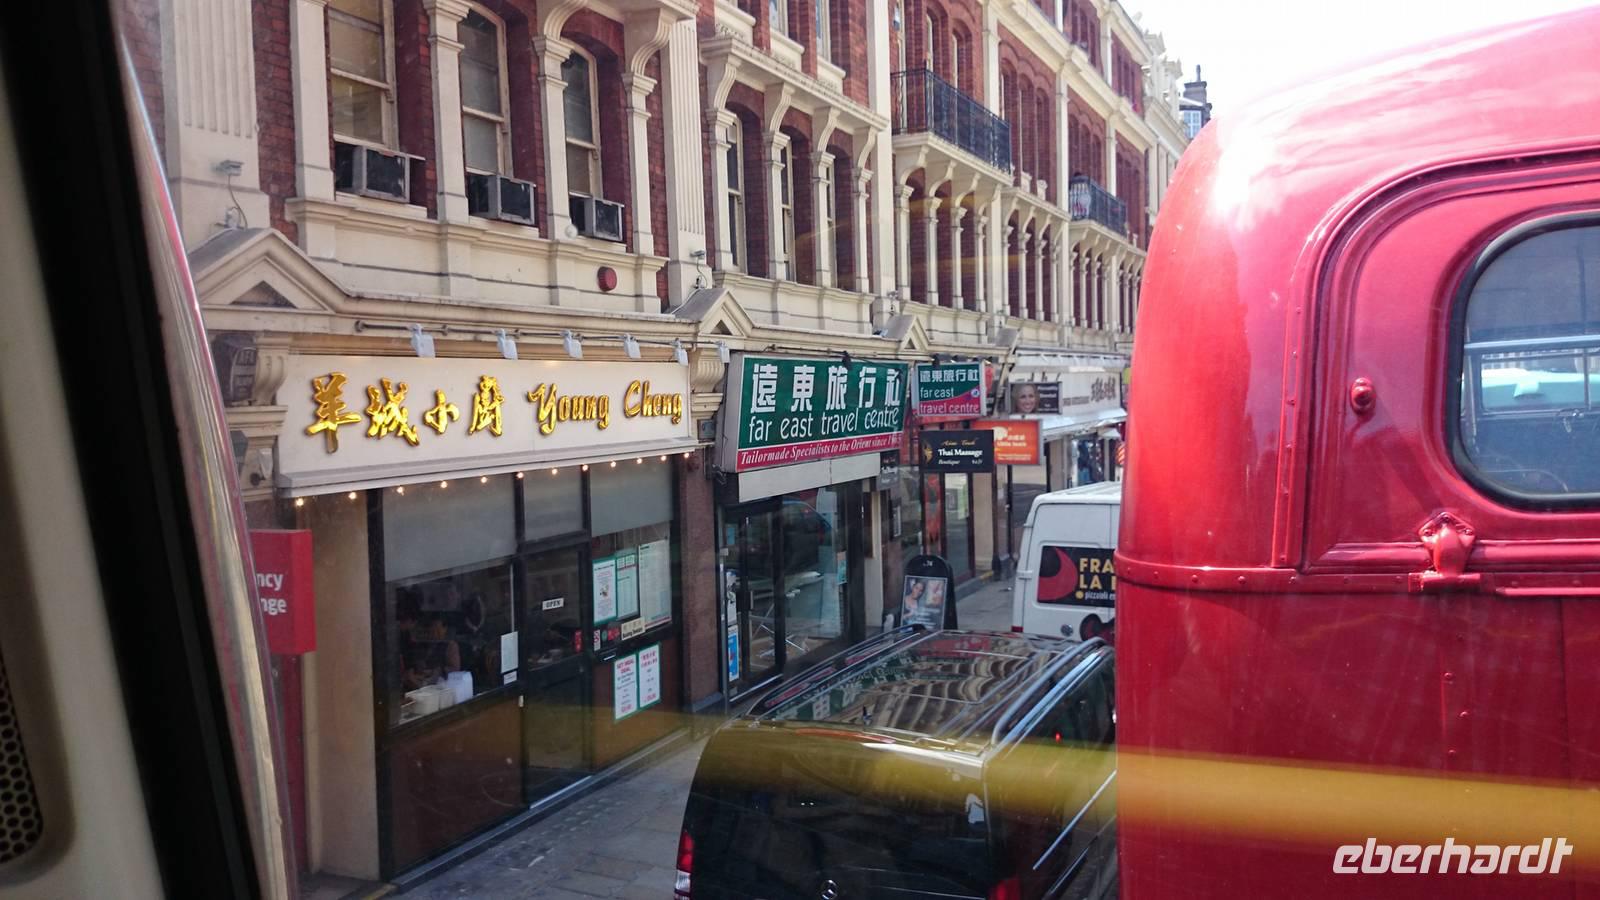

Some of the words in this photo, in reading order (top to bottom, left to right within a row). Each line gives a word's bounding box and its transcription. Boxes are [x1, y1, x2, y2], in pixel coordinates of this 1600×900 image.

[750, 363, 901, 413] 遠東旅行社
[920, 388, 933, 398] far
[934, 387, 954, 398] east
[527, 383, 609, 435] Young
[624, 380, 682, 424] Cheng
[920, 403, 946, 413] travel
[948, 403, 979, 413] centre
[749, 416, 773, 443] far
[780, 413, 813, 438] east
[821, 408, 859, 435] travel
[864, 407, 900, 430] centre
[741, 449, 789, 465] Tailormade
[790, 443, 830, 460] Specialists
[839, 442, 850, 451] the
[851, 439, 872, 449] Orient
[872, 438, 888, 448] since
[954, 449, 983, 457] Massage
[256, 573, 284, 591] ncy
[1080, 574, 1102, 590] LA
[545, 600, 561, 608] OPEN
